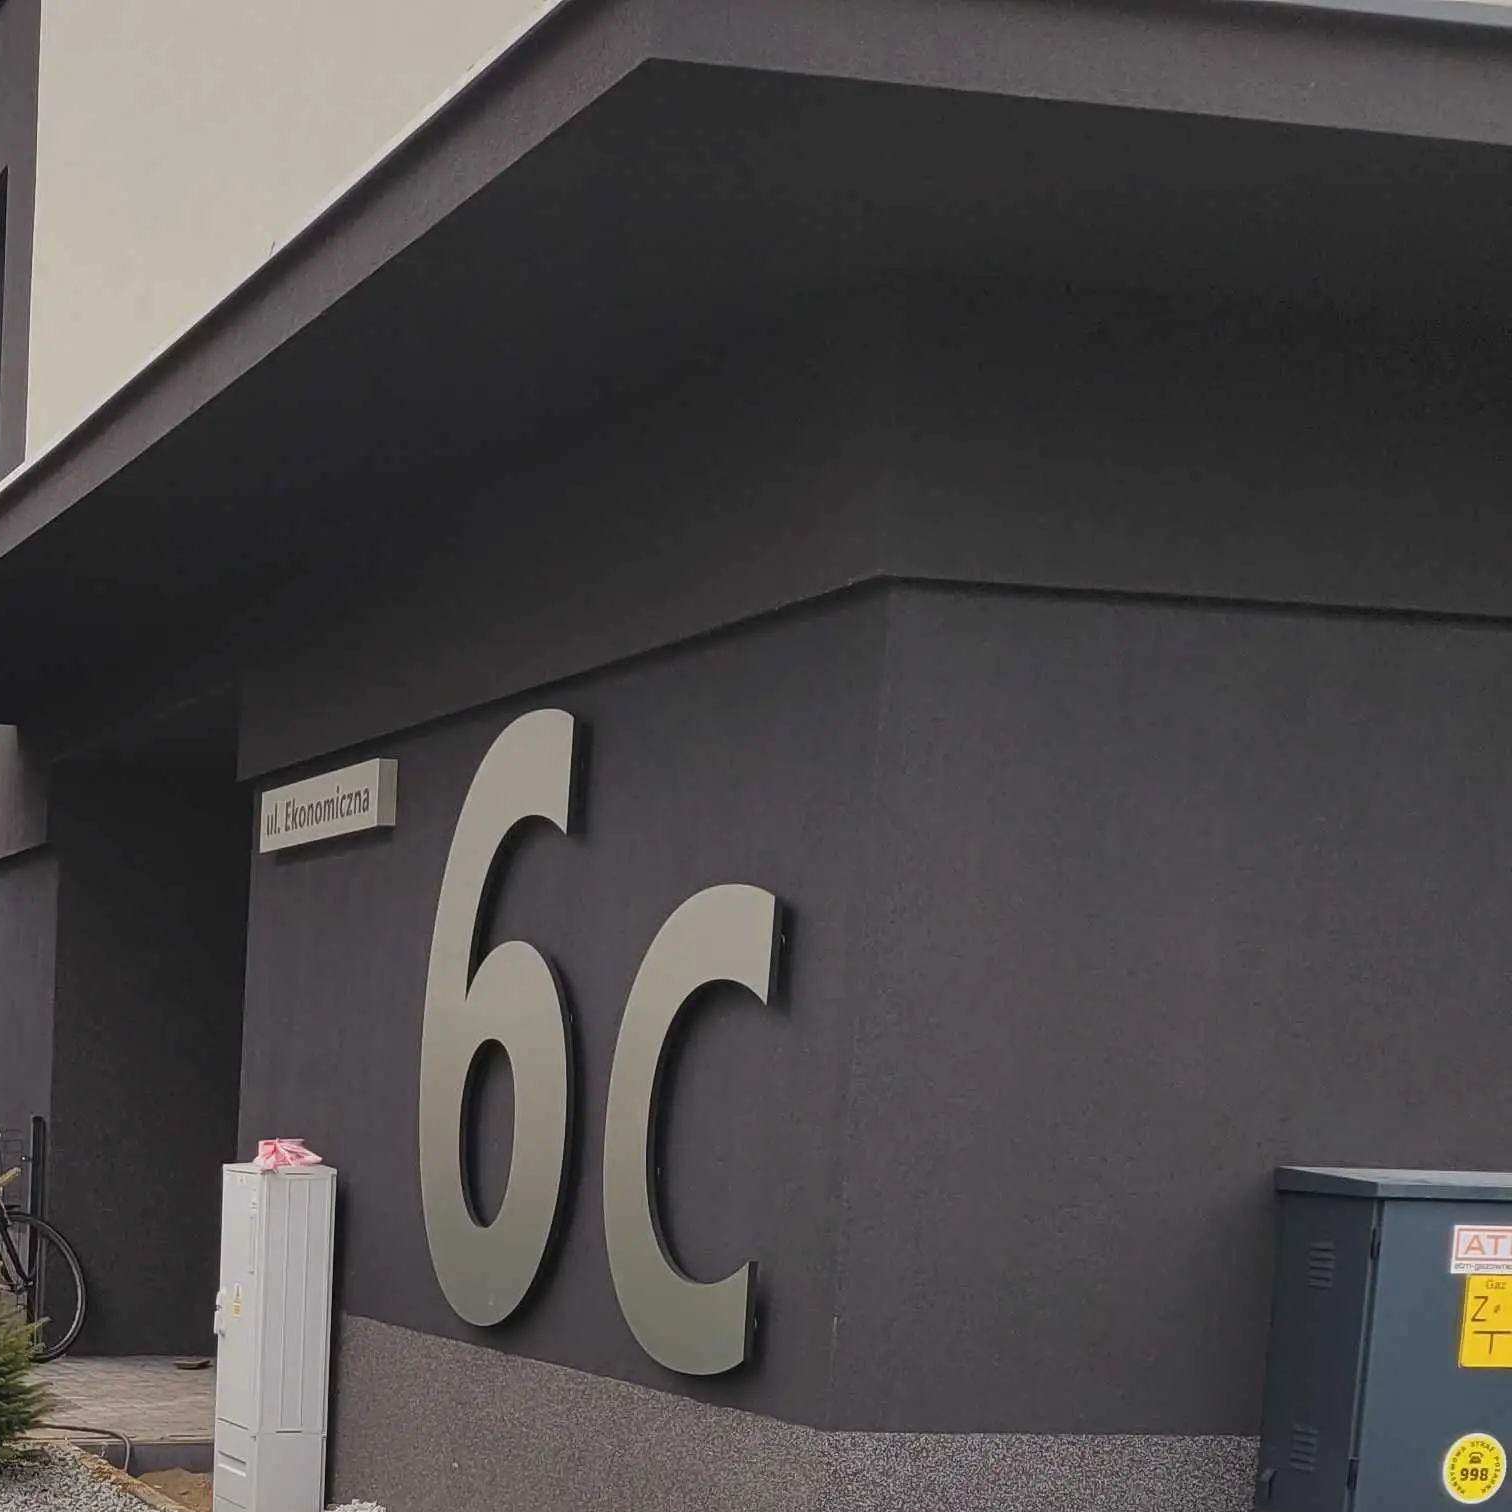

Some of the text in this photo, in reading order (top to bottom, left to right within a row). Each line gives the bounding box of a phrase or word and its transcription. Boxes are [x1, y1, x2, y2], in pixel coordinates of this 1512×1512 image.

[266, 785, 370, 837] ul. Ekonomiczna
[1463, 1234, 1512, 1255] AT
[1460, 1468, 1489, 1481] 998
